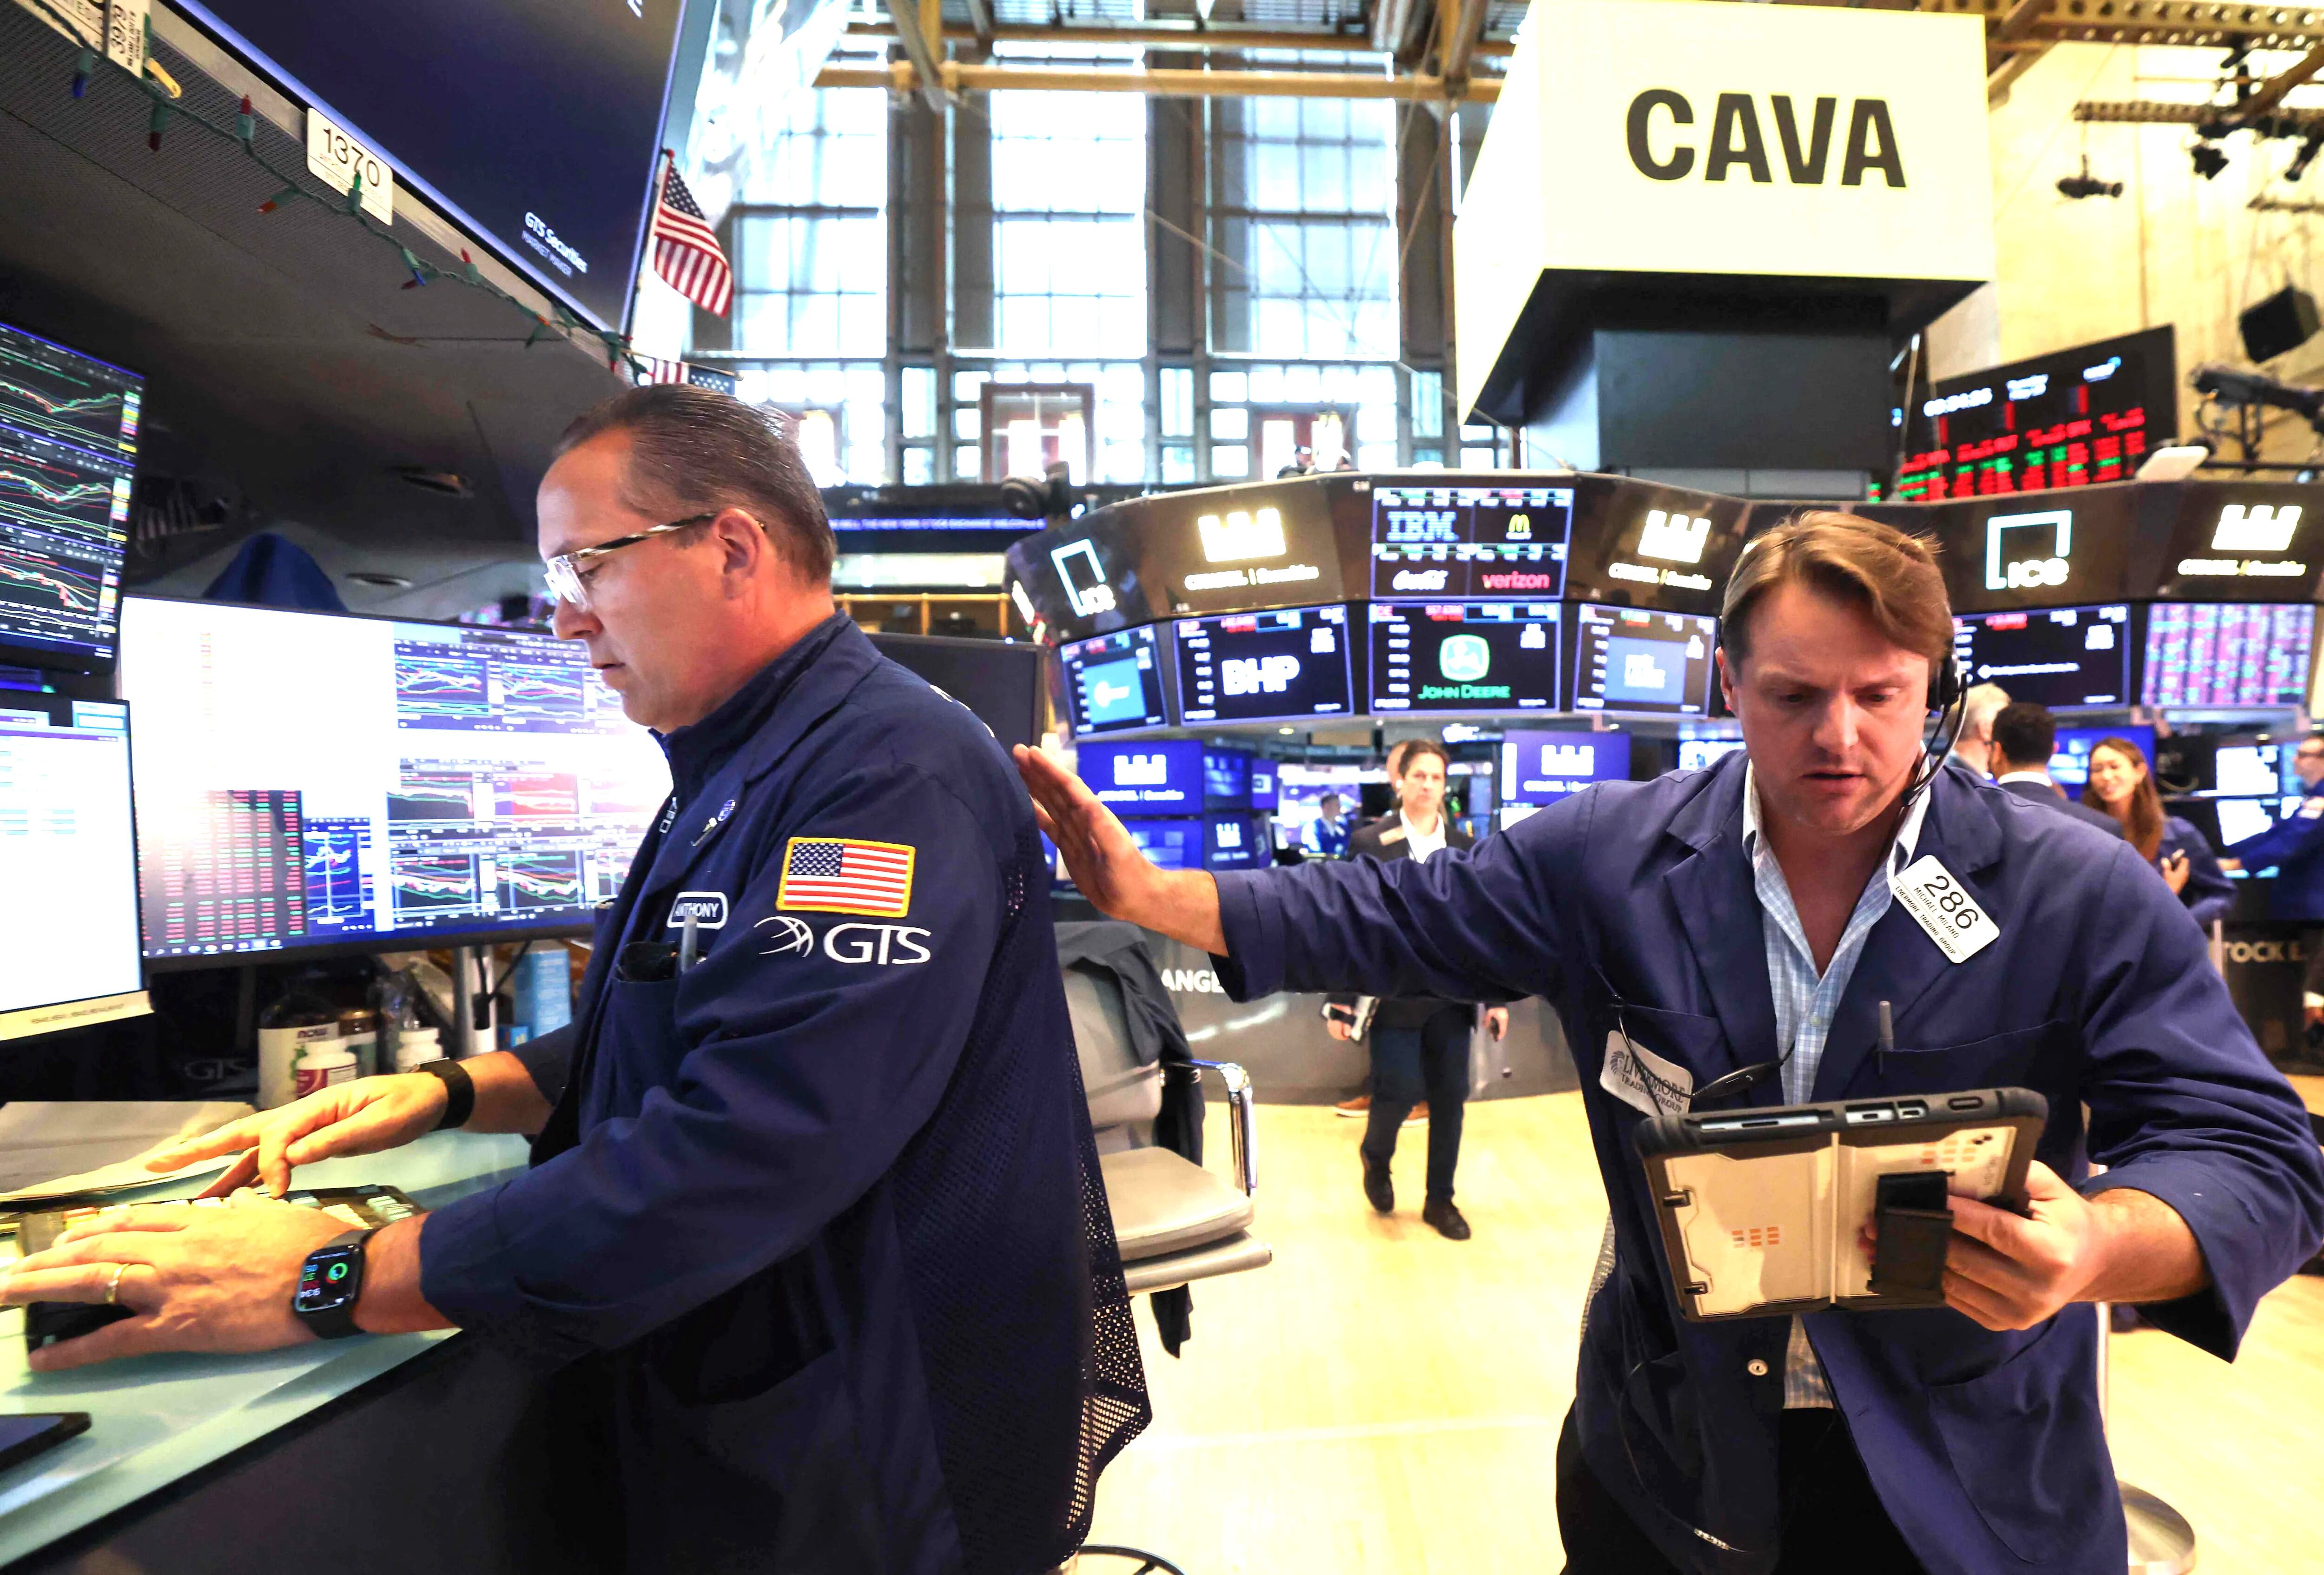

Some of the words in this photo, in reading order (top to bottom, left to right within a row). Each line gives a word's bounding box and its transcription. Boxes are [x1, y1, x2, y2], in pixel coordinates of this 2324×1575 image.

[323, 128, 380, 187] 1370
[1626, 89, 1906, 187] CAVA
[525, 212, 547, 238] GTS
[1387, 511, 1459, 542] IBM
[1482, 571, 1551, 589] verizon
[1221, 655, 1300, 695] BHP
[1895, 886, 1920, 913] LIVERMORE
[1920, 914, 1939, 936] TRADING
[1939, 937, 1956, 954] GROUP
[1914, 887, 1936, 914] MICHAEL
[1937, 915, 1959, 939] MILANO
[1923, 875, 1979, 929] 286
[823, 922, 931, 965] GTS
[2210, 941, 2284, 963] TOCK
[1623, 1056, 1686, 1104] LIVMORE
